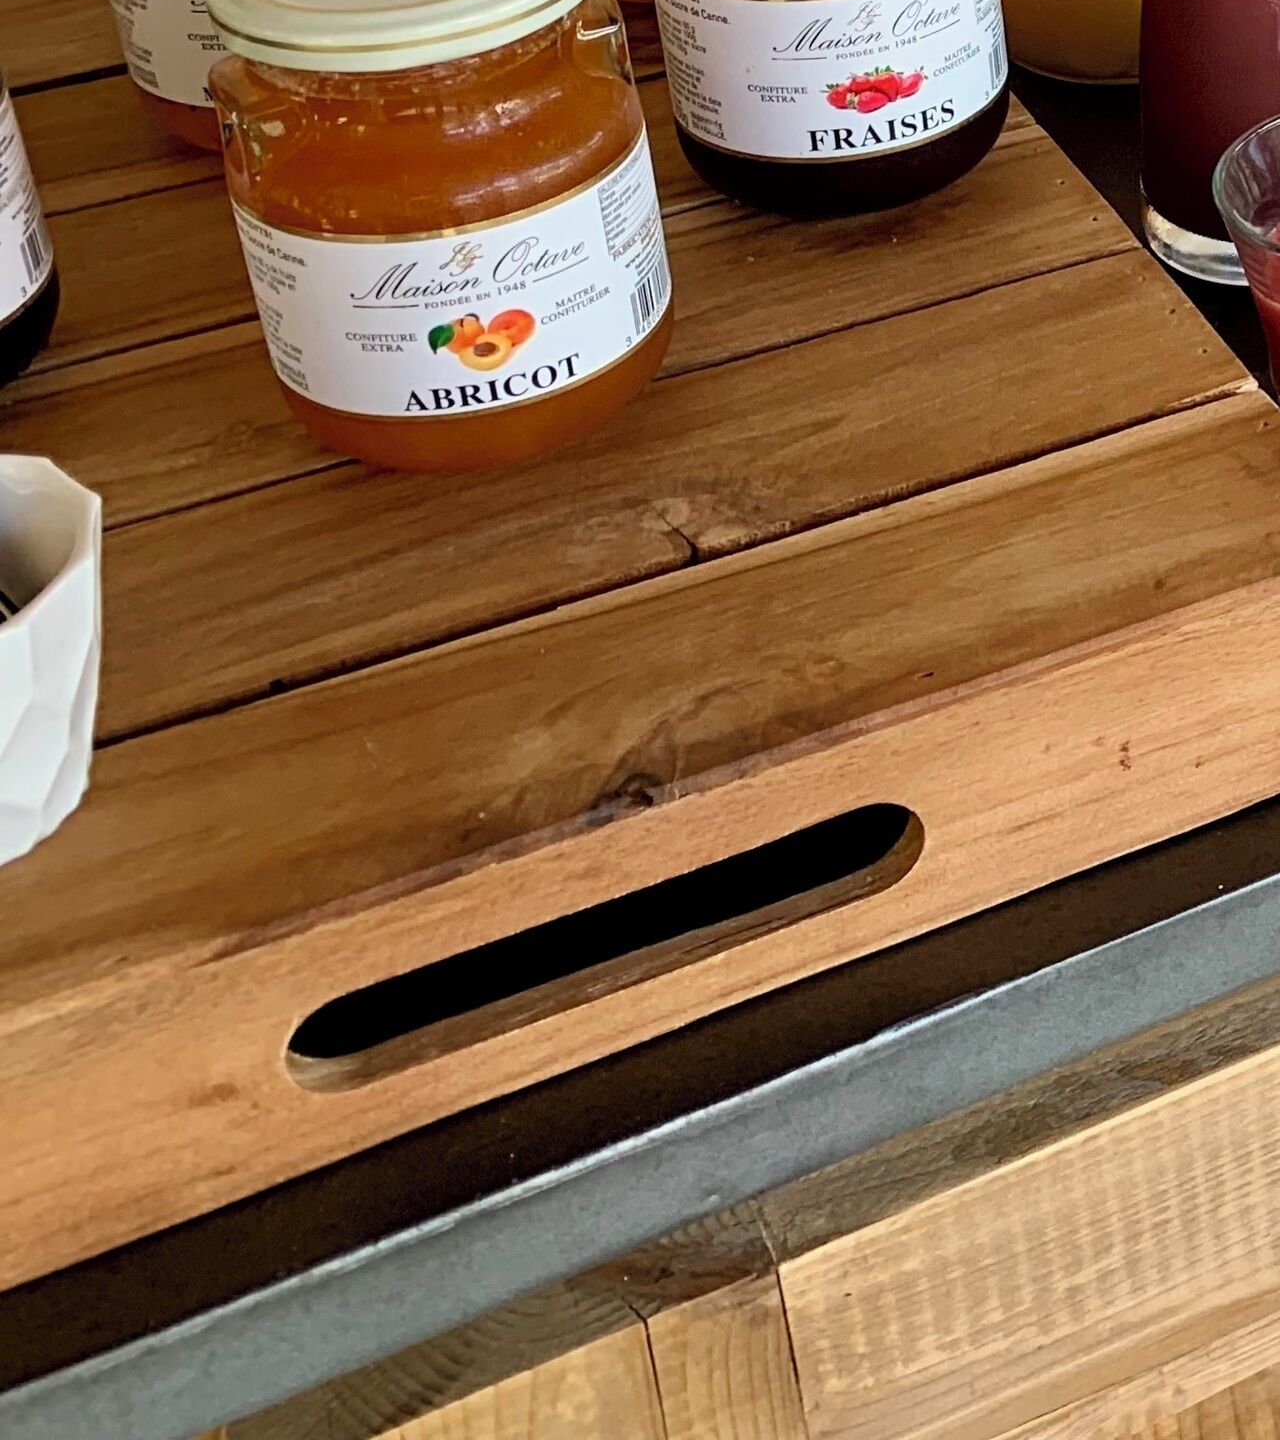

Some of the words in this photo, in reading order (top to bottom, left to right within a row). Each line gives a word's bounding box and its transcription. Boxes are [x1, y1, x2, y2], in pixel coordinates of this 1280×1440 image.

[773, 17, 884, 53] Maison
[747, 84, 809, 95] CONFITURE
[760, 94, 797, 104] EXTRA
[807, 99, 955, 152] FRAISES
[350, 260, 482, 302] Maison
[492, 236, 586, 283] Octave
[497, 280, 527, 297] 1948
[345, 331, 417, 343] CONFITURE
[361, 342, 404, 353] EXTRA
[404, 353, 581, 412] ABRICOT
